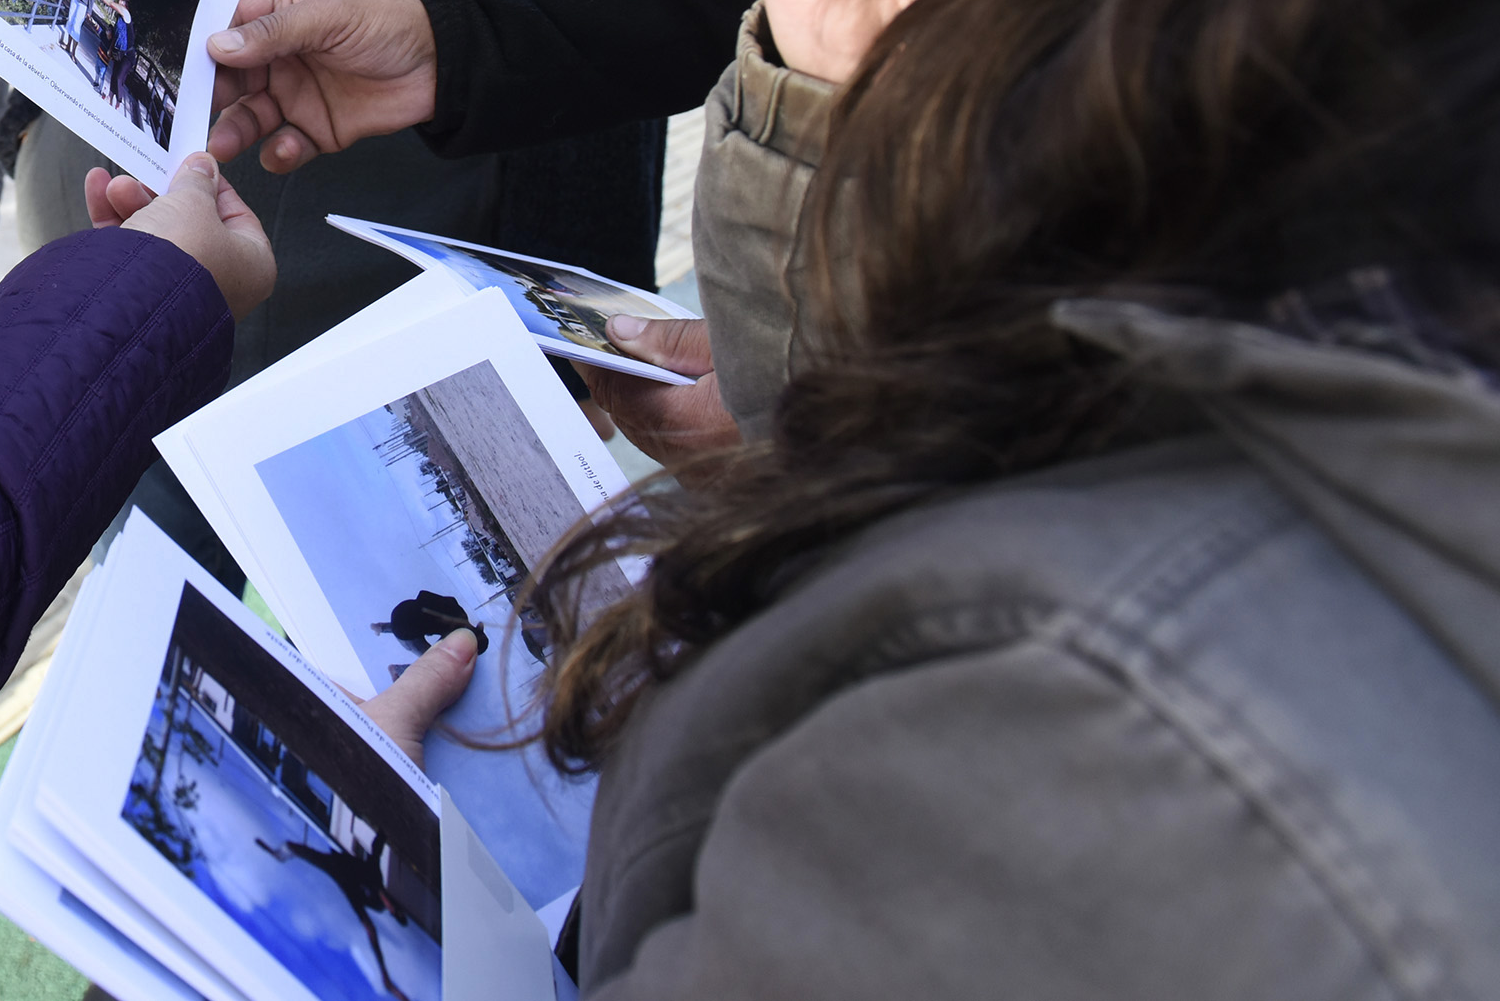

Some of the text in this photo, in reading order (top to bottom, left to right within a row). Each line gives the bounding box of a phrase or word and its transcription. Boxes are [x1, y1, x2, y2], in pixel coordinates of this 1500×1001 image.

[4, 45, 16, 57] casa
[16, 53, 22, 63] de
[21, 58, 28, 67] la
[50, 80, 79, 106] Observando
[83, 107, 101, 123] espacio
[100, 120, 115, 135] donde
[592, 479, 604, 490] de
